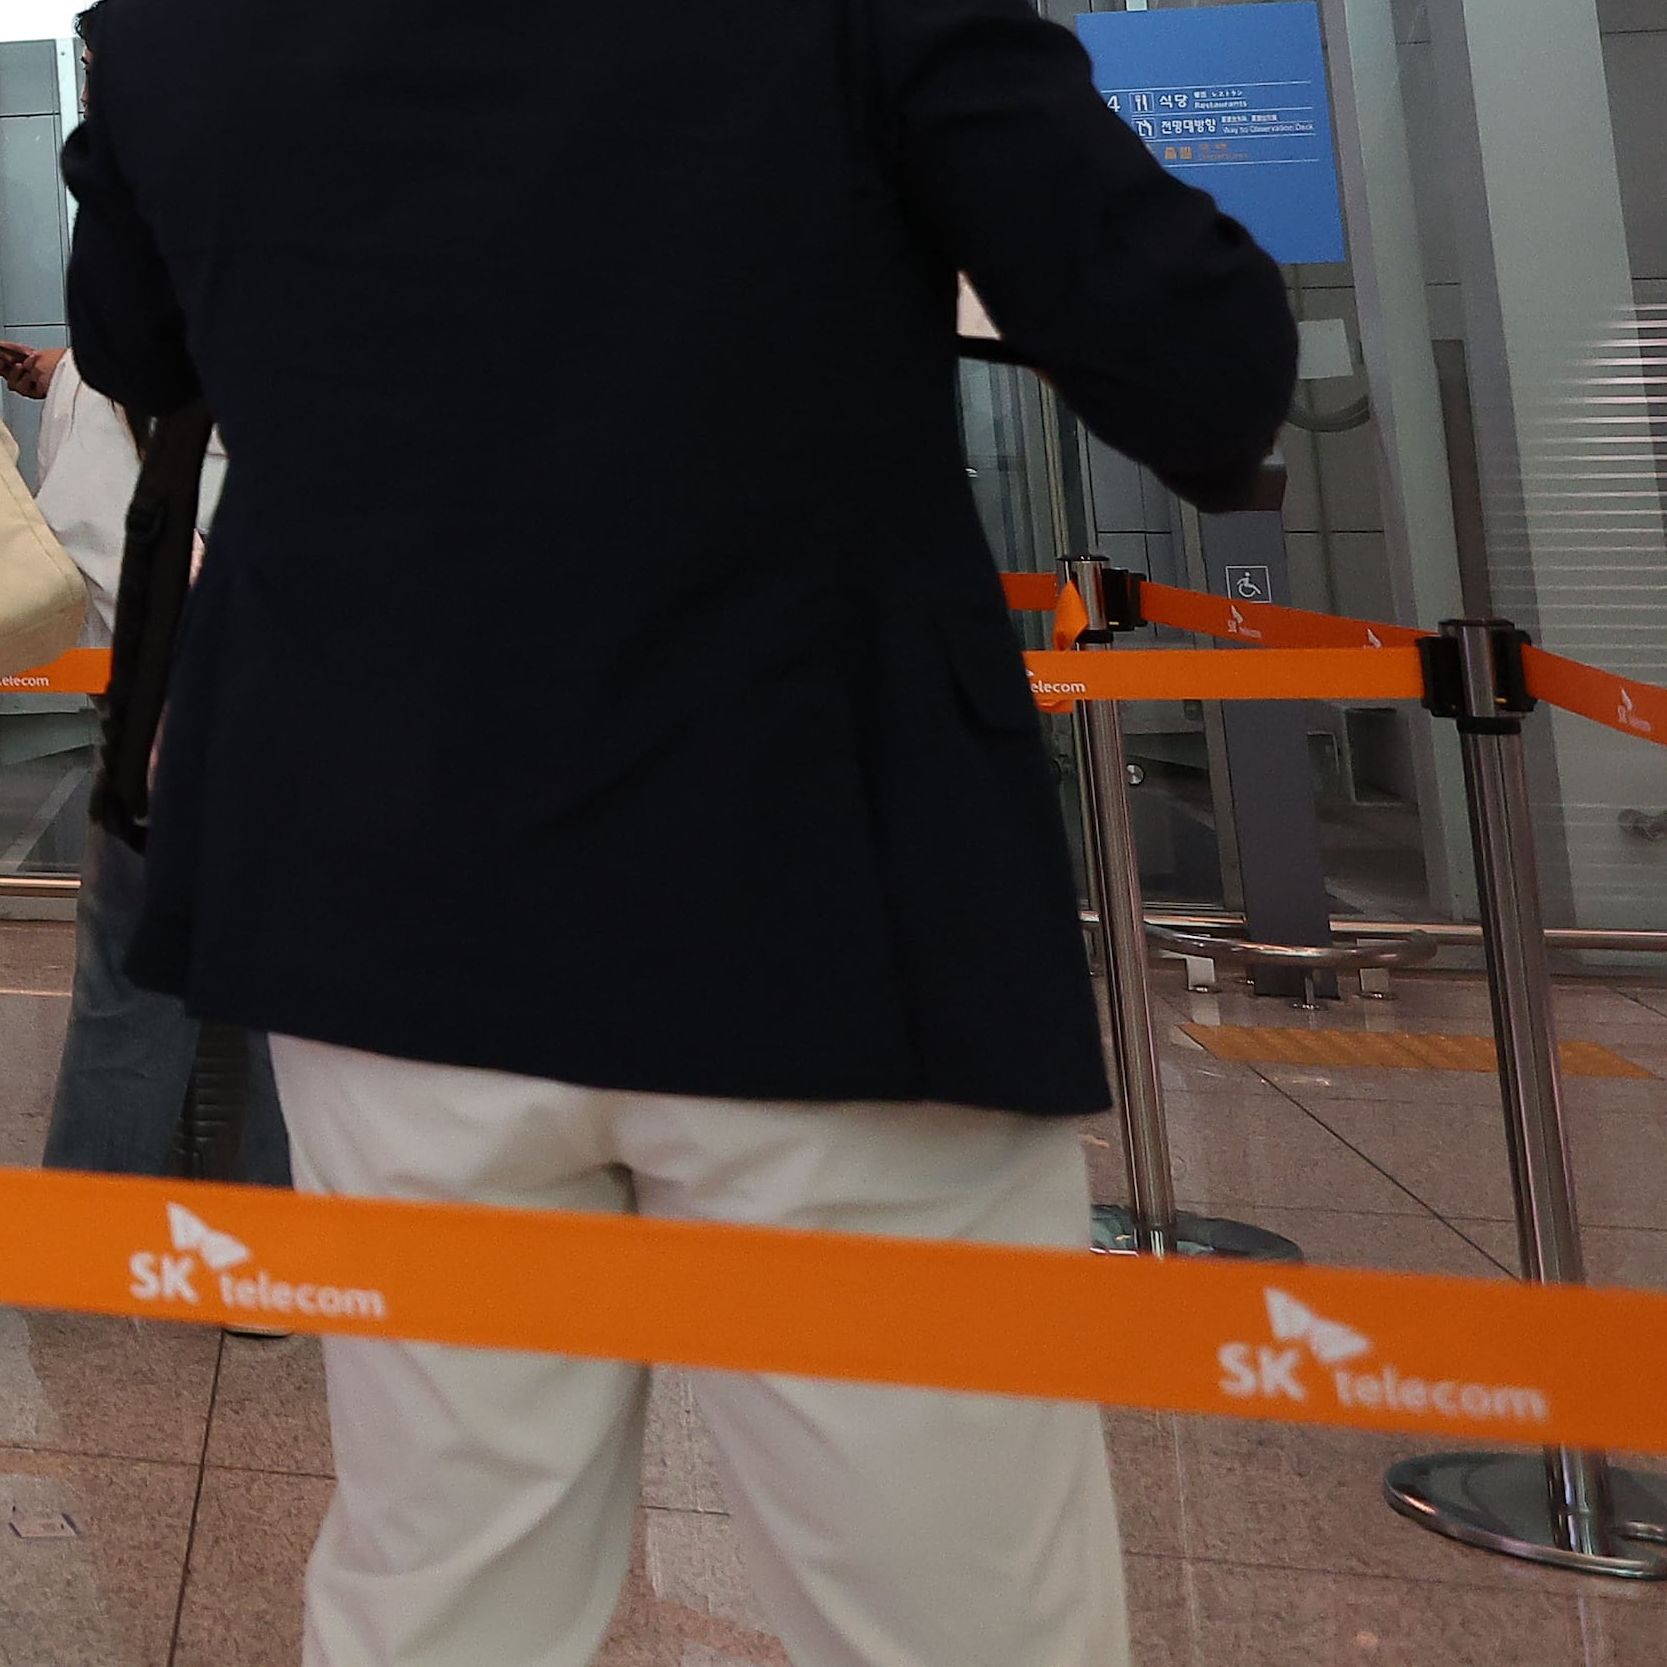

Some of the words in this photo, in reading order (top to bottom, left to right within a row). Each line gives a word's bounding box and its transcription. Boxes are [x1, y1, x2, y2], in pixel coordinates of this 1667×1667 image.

[1107, 95, 1121, 112] 4
[1159, 94, 1189, 108] 식당
[1193, 101, 1248, 109] Restaurants
[1161, 118, 1217, 135] 전망대방향
[1029, 678, 1086, 694] elecom
[130, 1251, 199, 1303] SK
[218, 1270, 387, 1320] telecom
[1217, 1340, 1306, 1403] SK
[1334, 1361, 1549, 1423] telecom
